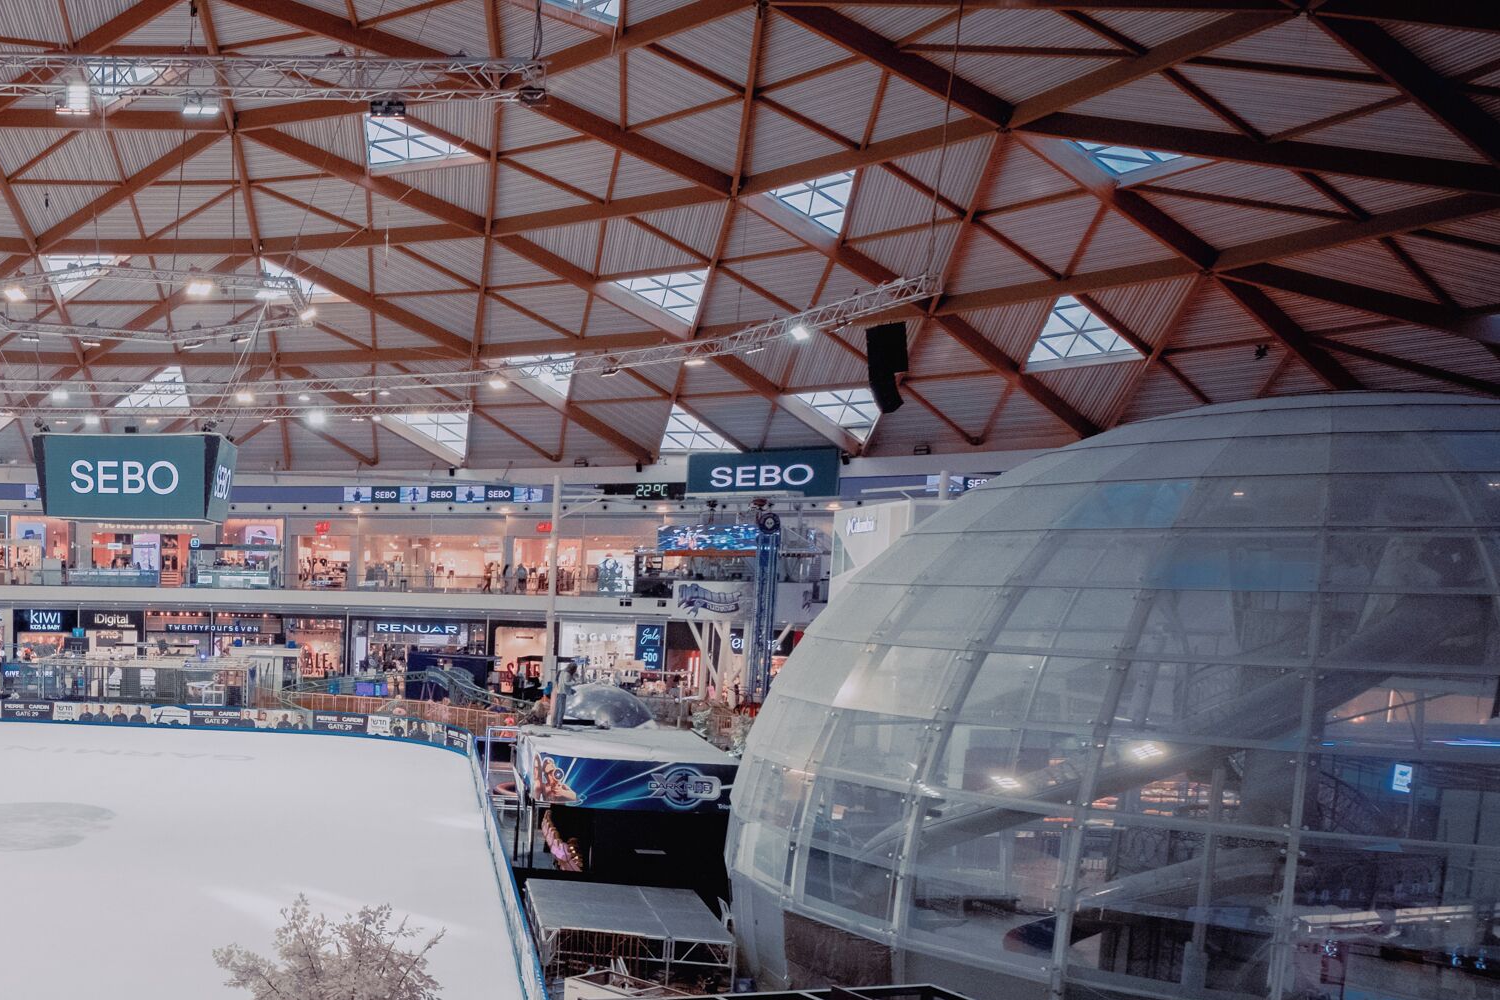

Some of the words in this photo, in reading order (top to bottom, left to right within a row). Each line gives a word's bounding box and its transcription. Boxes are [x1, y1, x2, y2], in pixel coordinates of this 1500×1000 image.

[70, 459, 179, 495] SEBO
[709, 464, 814, 487] SEBO
[213, 464, 231, 500] SEBO
[374, 490, 396, 499] SEBO
[430, 490, 452, 499] SEBO
[488, 489, 510, 498] SEBO
[94, 613, 129, 627] iDigital
[376, 623, 459, 634] RENUAR
[640, 627, 660, 645] Sale
[642, 652, 658, 663] 500
[204, 717, 221, 725] GATE
[327, 723, 345, 731] GATE
